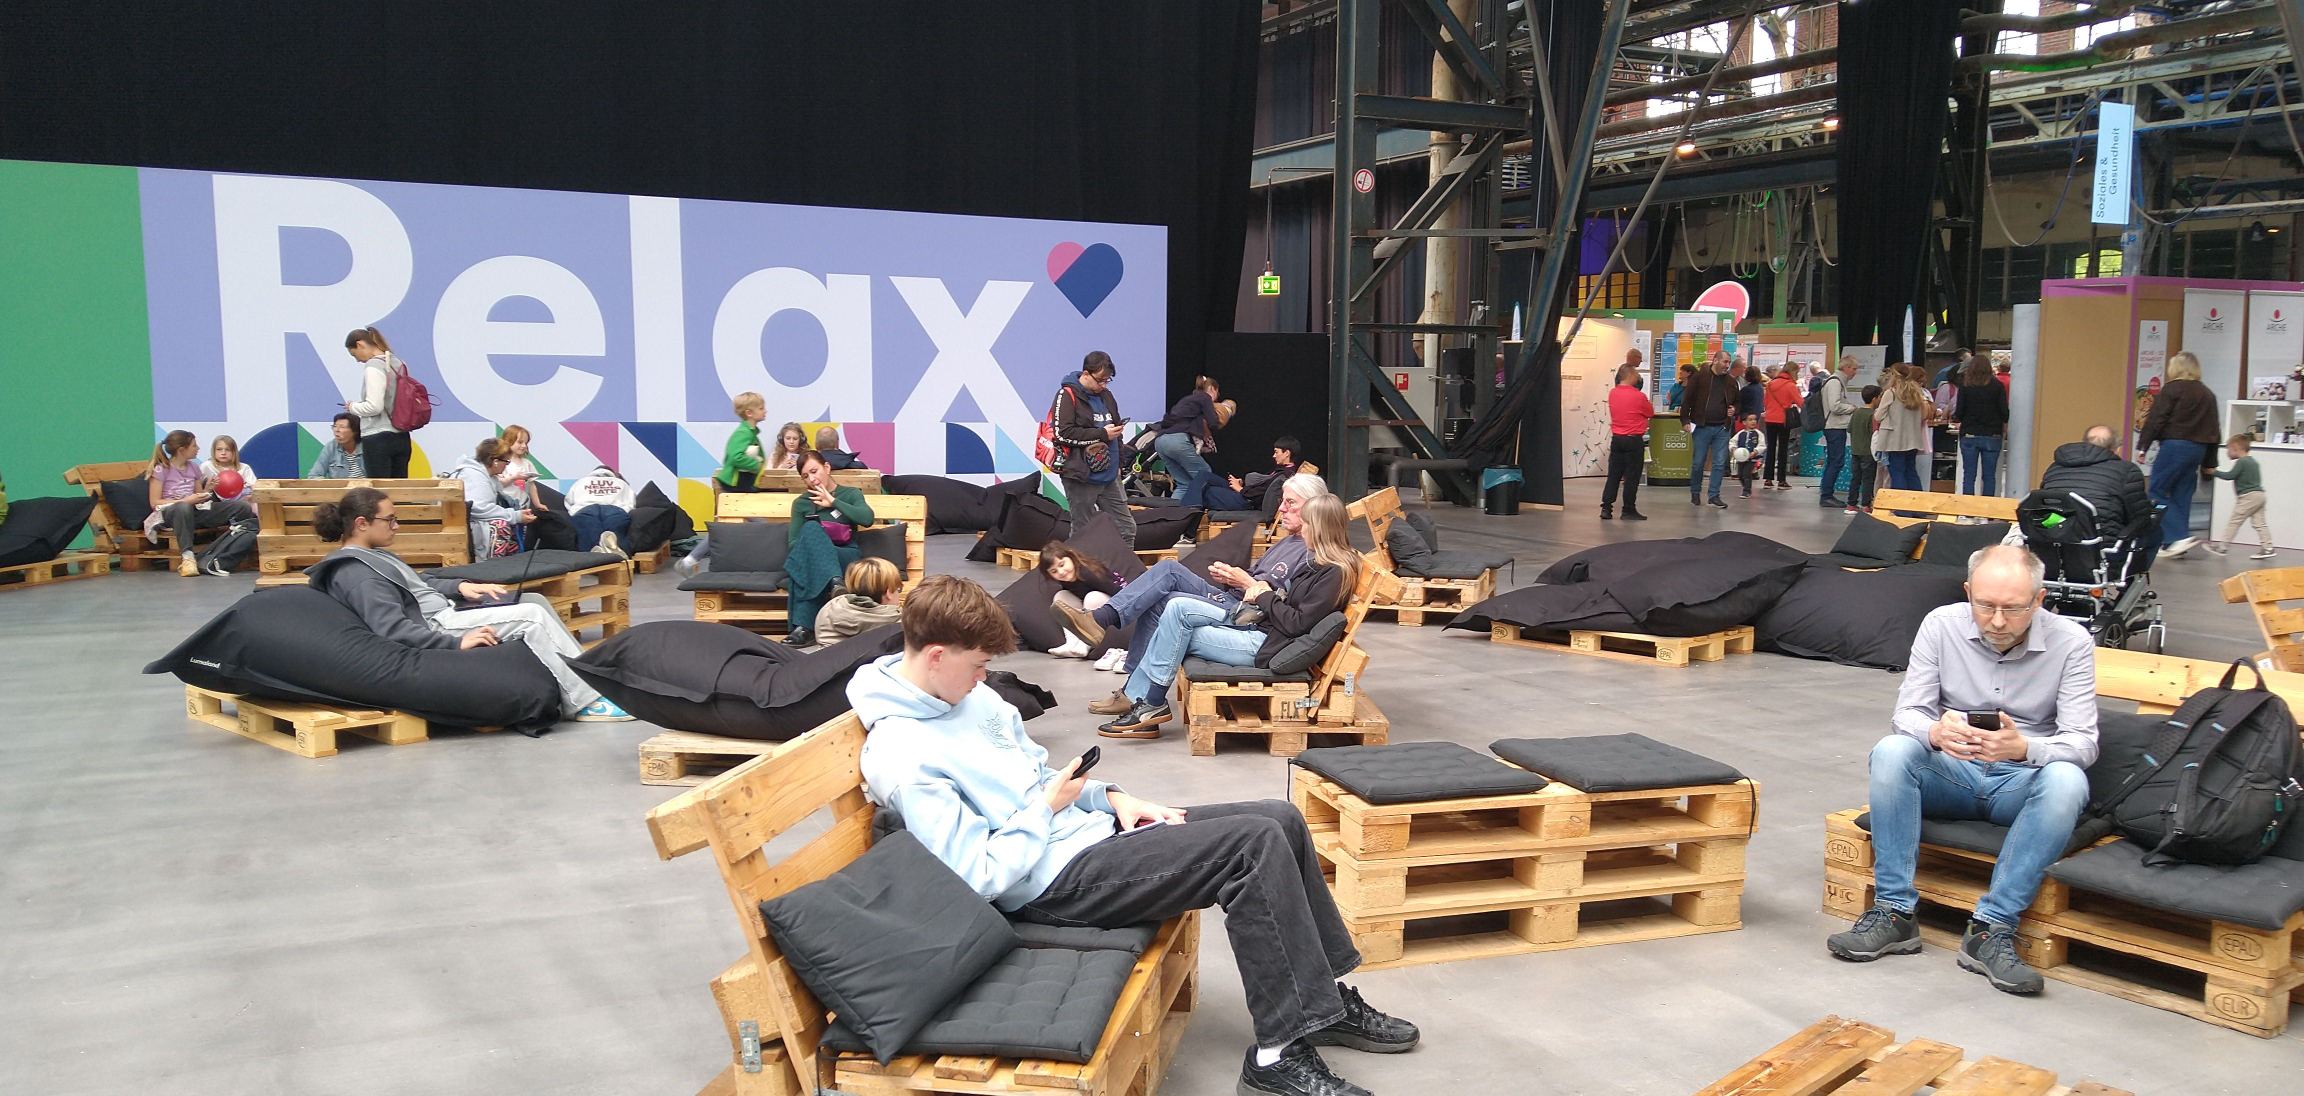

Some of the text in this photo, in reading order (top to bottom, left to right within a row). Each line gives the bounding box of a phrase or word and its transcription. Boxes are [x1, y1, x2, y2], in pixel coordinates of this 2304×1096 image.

[2109, 128, 2120, 195] Gesundheit
[2096, 157, 2108, 219] Soziales &
[213, 174, 1044, 424] Relax
[2202, 322, 2224, 330] ARCHE
[2266, 323, 2287, 331] ARCHE
[1831, 843, 1855, 859] EPAL
[2223, 937, 2257, 958] EPAL
[2222, 996, 2249, 1016] EUR
